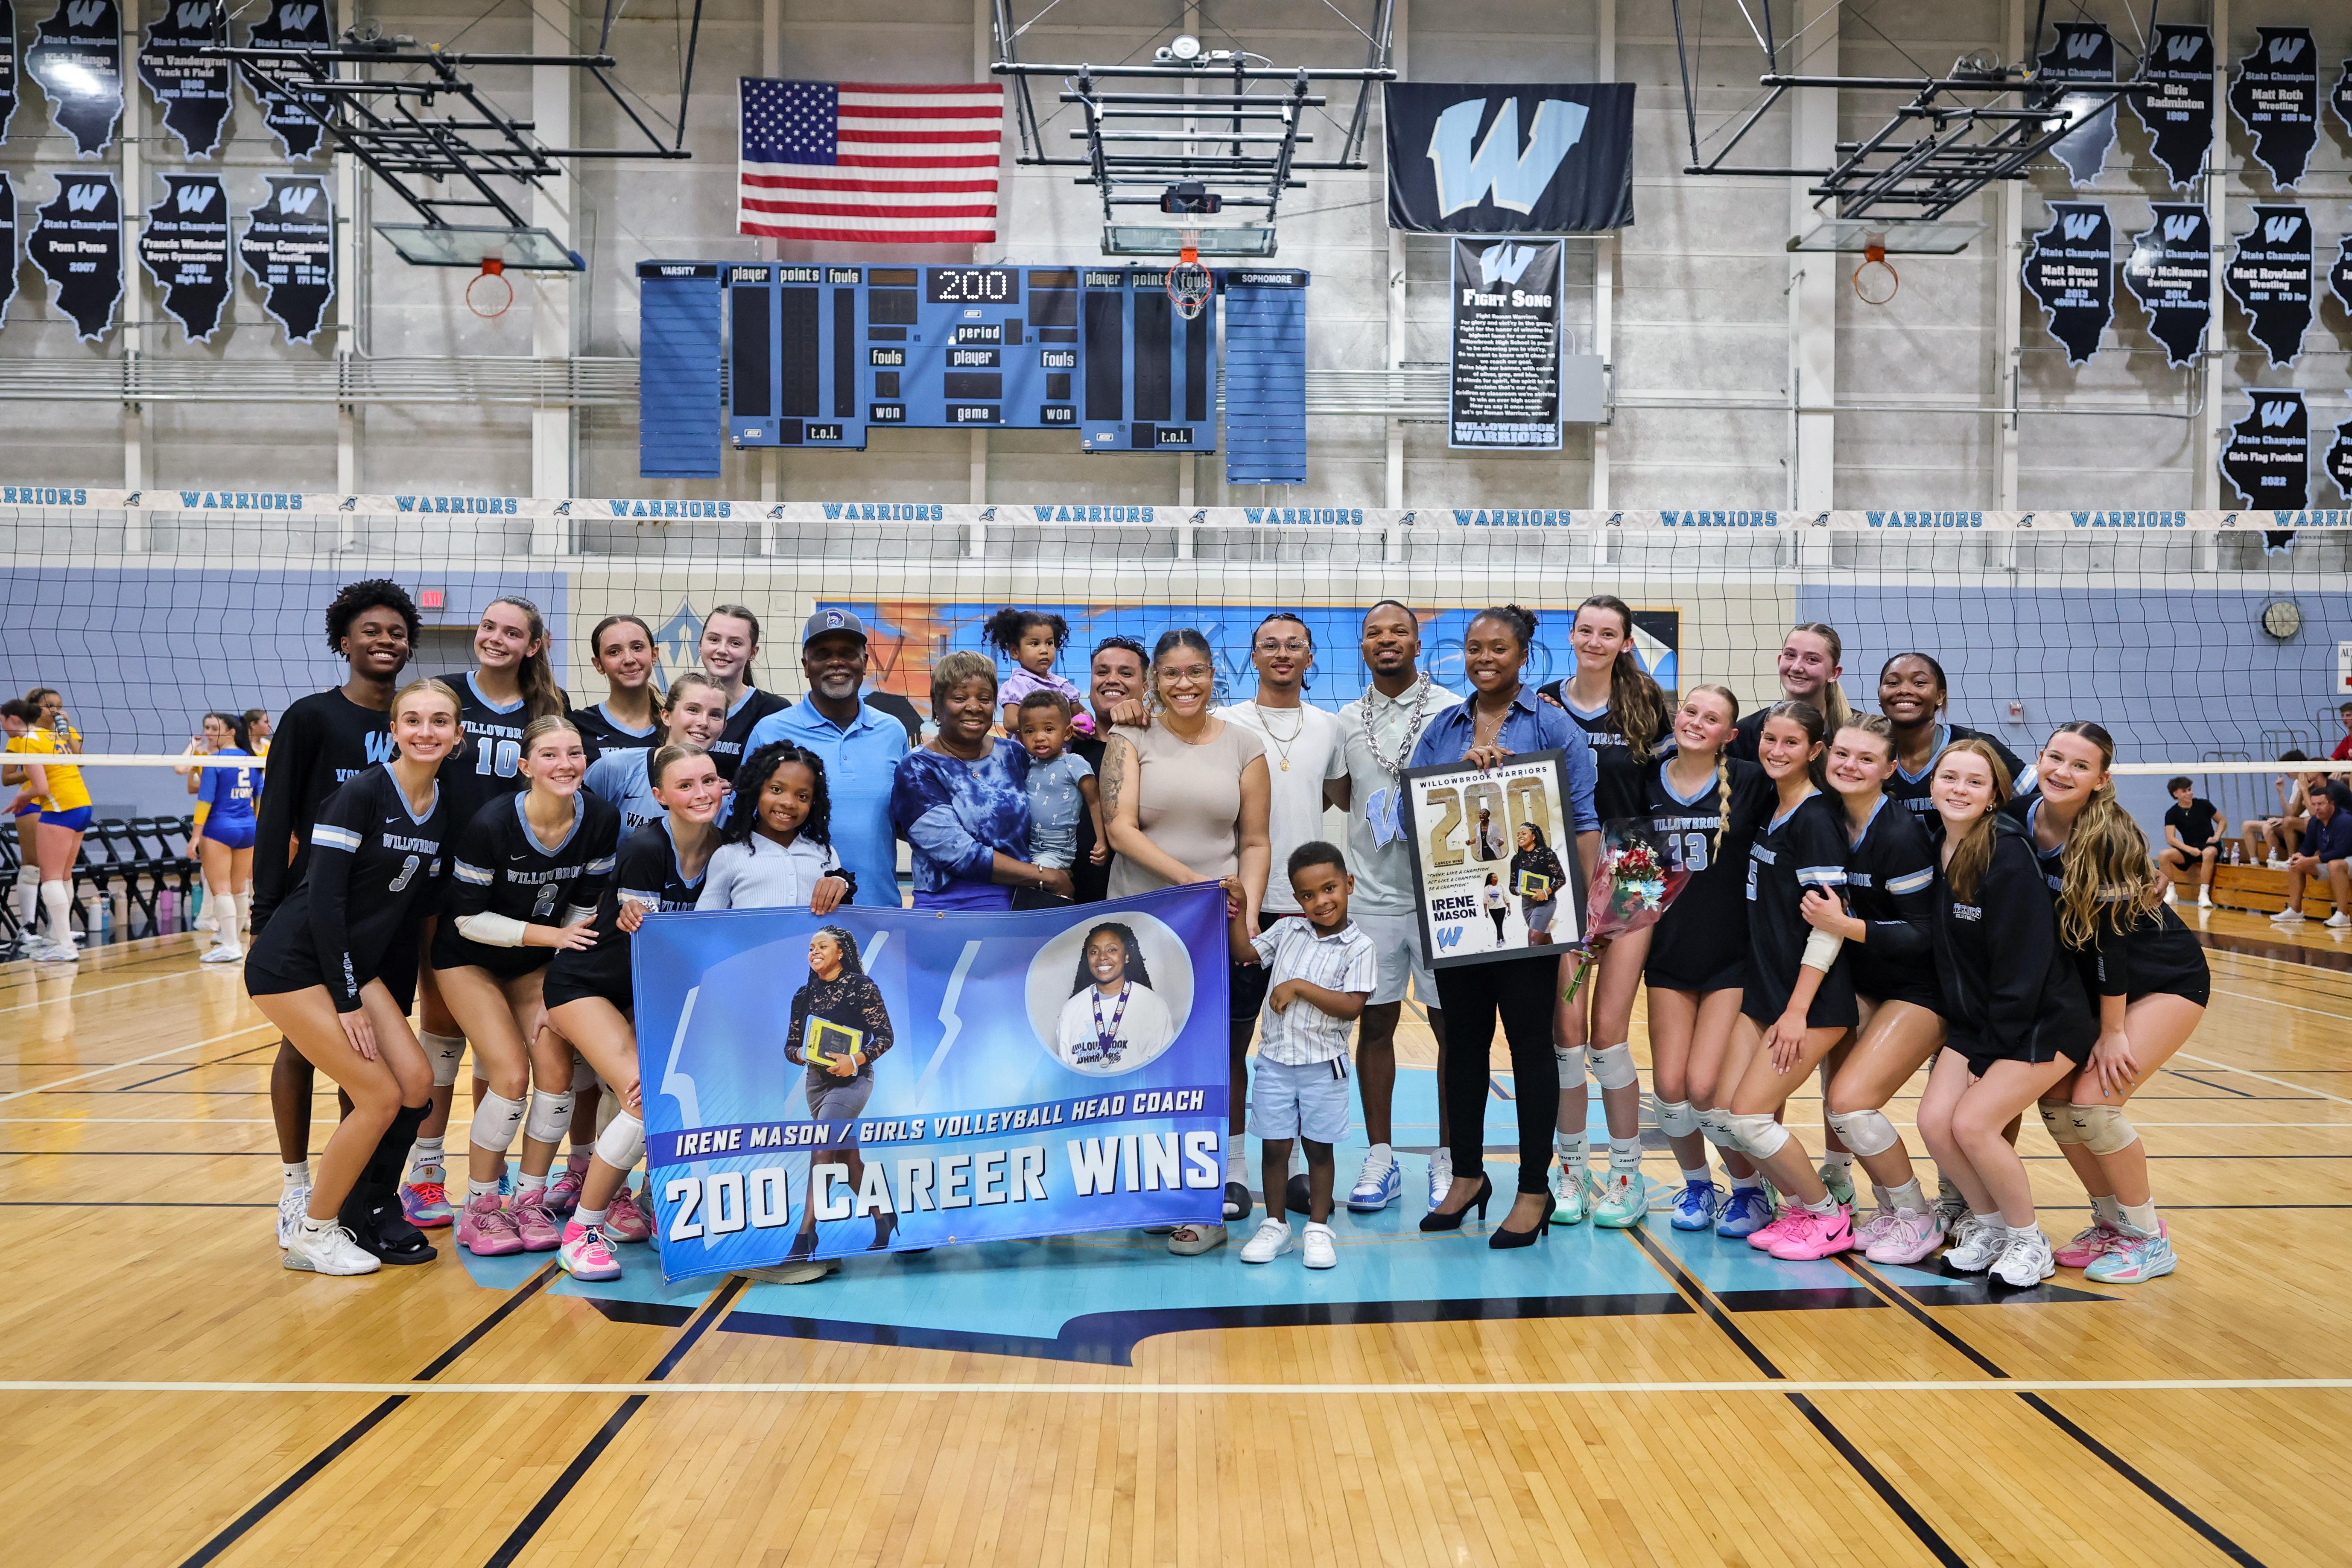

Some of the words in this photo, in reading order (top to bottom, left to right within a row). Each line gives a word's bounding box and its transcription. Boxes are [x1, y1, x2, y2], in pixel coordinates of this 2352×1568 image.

[67, 0, 105, 27] W
[2167, 35, 2204, 62] W
[2269, 37, 2306, 64] W
[2271, 72, 2315, 82] Champion
[2147, 96, 2205, 109] Badminton
[2252, 88, 2276, 100] Matt
[2278, 89, 2304, 100] Roth
[2259, 101, 2299, 112] Wrestling
[1426, 96, 1590, 219] W
[67, 184, 107, 212] W
[2063, 213, 2101, 241] W
[2163, 214, 2201, 242] W
[2264, 216, 2302, 244] W
[49, 240, 76, 253] Pom
[2065, 248, 2109, 260] Champion
[1478, 244, 1537, 285] W
[2266, 251, 2311, 263] Champion
[660, 266, 695, 276] VARSITY
[732, 268, 768, 282] player
[780, 268, 819, 282] points
[829, 269, 859, 283] fouls
[1242, 273, 1292, 283] SOPHOMORE
[2041, 264, 2065, 276] Matt
[2233, 267, 2258, 280] Matt
[2259, 267, 2307, 280] Rowland
[939, 271, 1006, 299] 200
[1086, 272, 1121, 287] player
[1133, 273, 1169, 287] points
[1181, 274, 1211, 287] fouls
[2249, 279, 2290, 291] Wrestling
[958, 326, 999, 341] period
[873, 350, 902, 365] fouls
[954, 350, 992, 366] player
[1043, 351, 1074, 367] fouls
[876, 408, 900, 419] won
[957, 409, 989, 422] game
[1046, 409, 1071, 420] won
[2260, 400, 2298, 428] W
[1455, 422, 1556, 432] WILLOWBROOK
[1455, 430, 1556, 443] WARRIORS
[2237, 435, 2261, 445] State
[2263, 435, 2306, 447] Champion
[2229, 452, 2249, 462] Girls
[2250, 452, 2269, 464] Flag
[2270, 453, 2304, 463] Football
[0, 487, 86, 505] RRIORS
[180, 492, 303, 510] WARRIORS
[395, 496, 517, 514] WARRIORS
[609, 500, 730, 517] WARRIORS
[822, 503, 943, 521] WARRIORS
[1034, 505, 1154, 523] WARRIORS
[1244, 508, 1363, 525] WARRIORS
[1453, 510, 1571, 527] WARRIORS
[1660, 510, 1777, 527] WARRIORS
[1866, 511, 1982, 528] WARRIORS
[2071, 511, 2186, 528] WARRIORS
[2274, 511, 2352, 526] WARRI
[422, 590, 442, 607] EXIT
[461, 721, 524, 739] ILLOWBR
[476, 737, 521, 778] 10
[1420, 774, 1492, 788] WILLOWBROOK
[1496, 766, 1547, 778] WARRIORS
[1426, 777, 1551, 867] 200
[1668, 832, 1708, 872] 13
[389, 855, 420, 892] 3
[1746, 859, 1758, 901] 5
[532, 883, 559, 917] 2
[1432, 895, 1475, 911] IRENE
[1434, 908, 1477, 922] MASON
[1437, 926, 1464, 949] W
[675, 1127, 742, 1156] IRENE
[750, 1124, 830, 1149] MASON
[859, 1117, 925, 1143] GIRLS
[933, 1103, 1064, 1137] VOLLEYBALL
[1071, 1095, 1126, 1120] HEAD
[1132, 1090, 1205, 1114] COACH
[664, 1165, 790, 1243] 200
[812, 1145, 1049, 1222] CAREER
[1066, 1130, 1221, 1197] WINS
